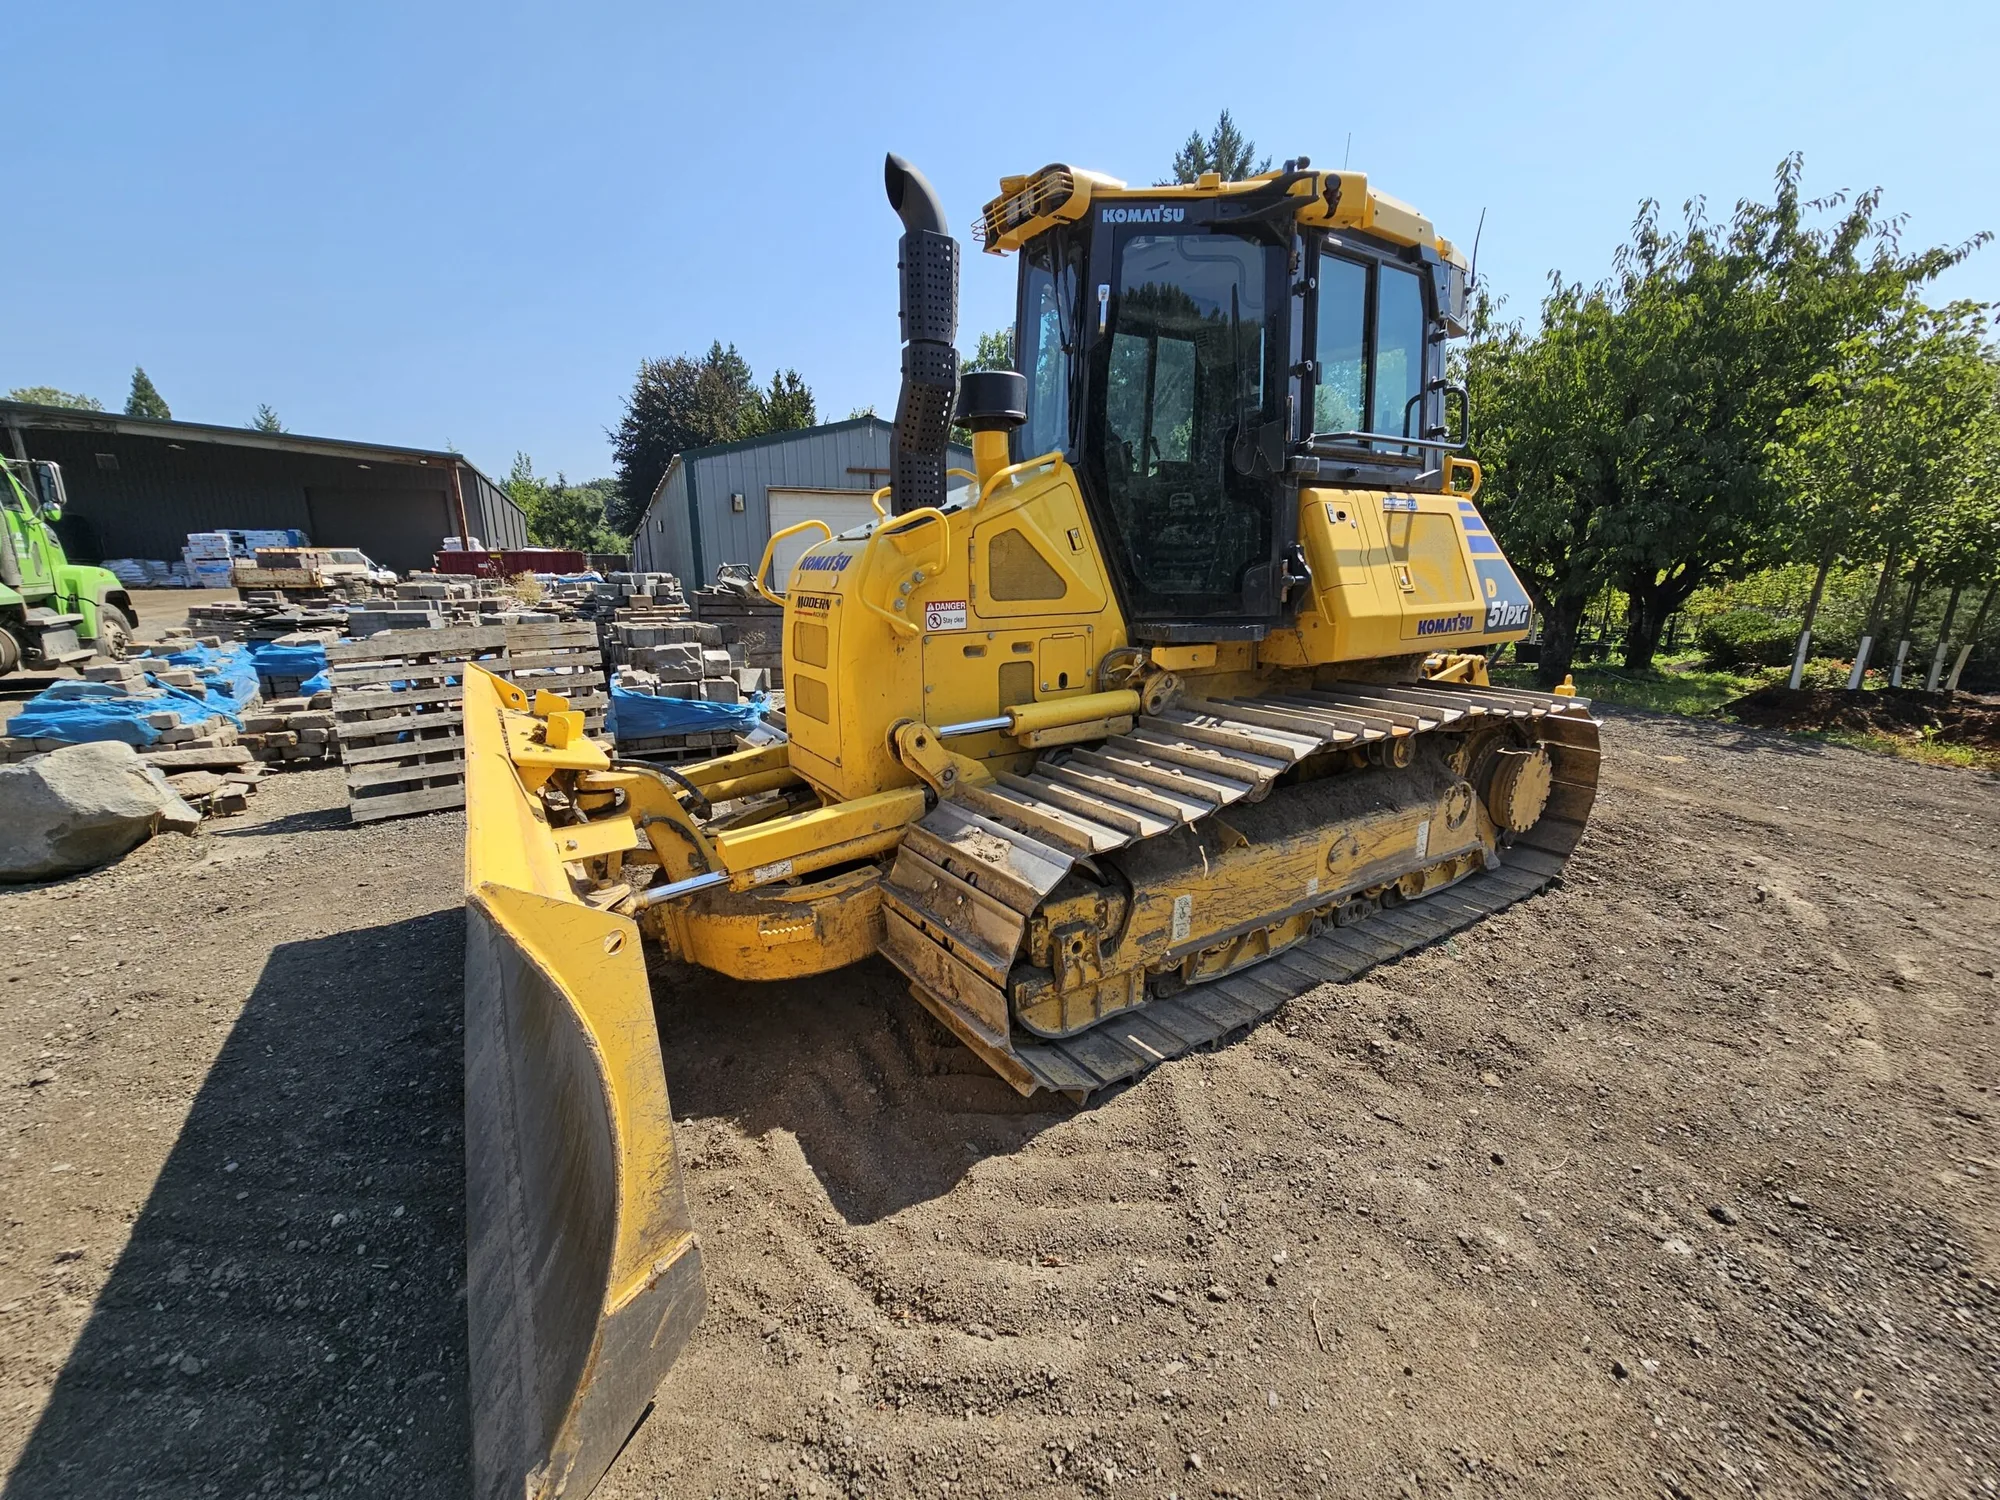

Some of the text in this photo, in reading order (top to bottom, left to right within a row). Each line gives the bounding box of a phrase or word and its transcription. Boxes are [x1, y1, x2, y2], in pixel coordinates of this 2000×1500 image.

[1102, 204, 1184, 223] KOMATSU
[798, 552, 853, 571] KOMATSU
[1485, 578, 1498, 598] D
[796, 595, 832, 610] MODERN
[935, 601, 966, 611] DANGER
[943, 616, 965, 625] Stay clear
[1487, 600, 1529, 628] 51PXi
[1417, 613, 1473, 635] KOMATSU
